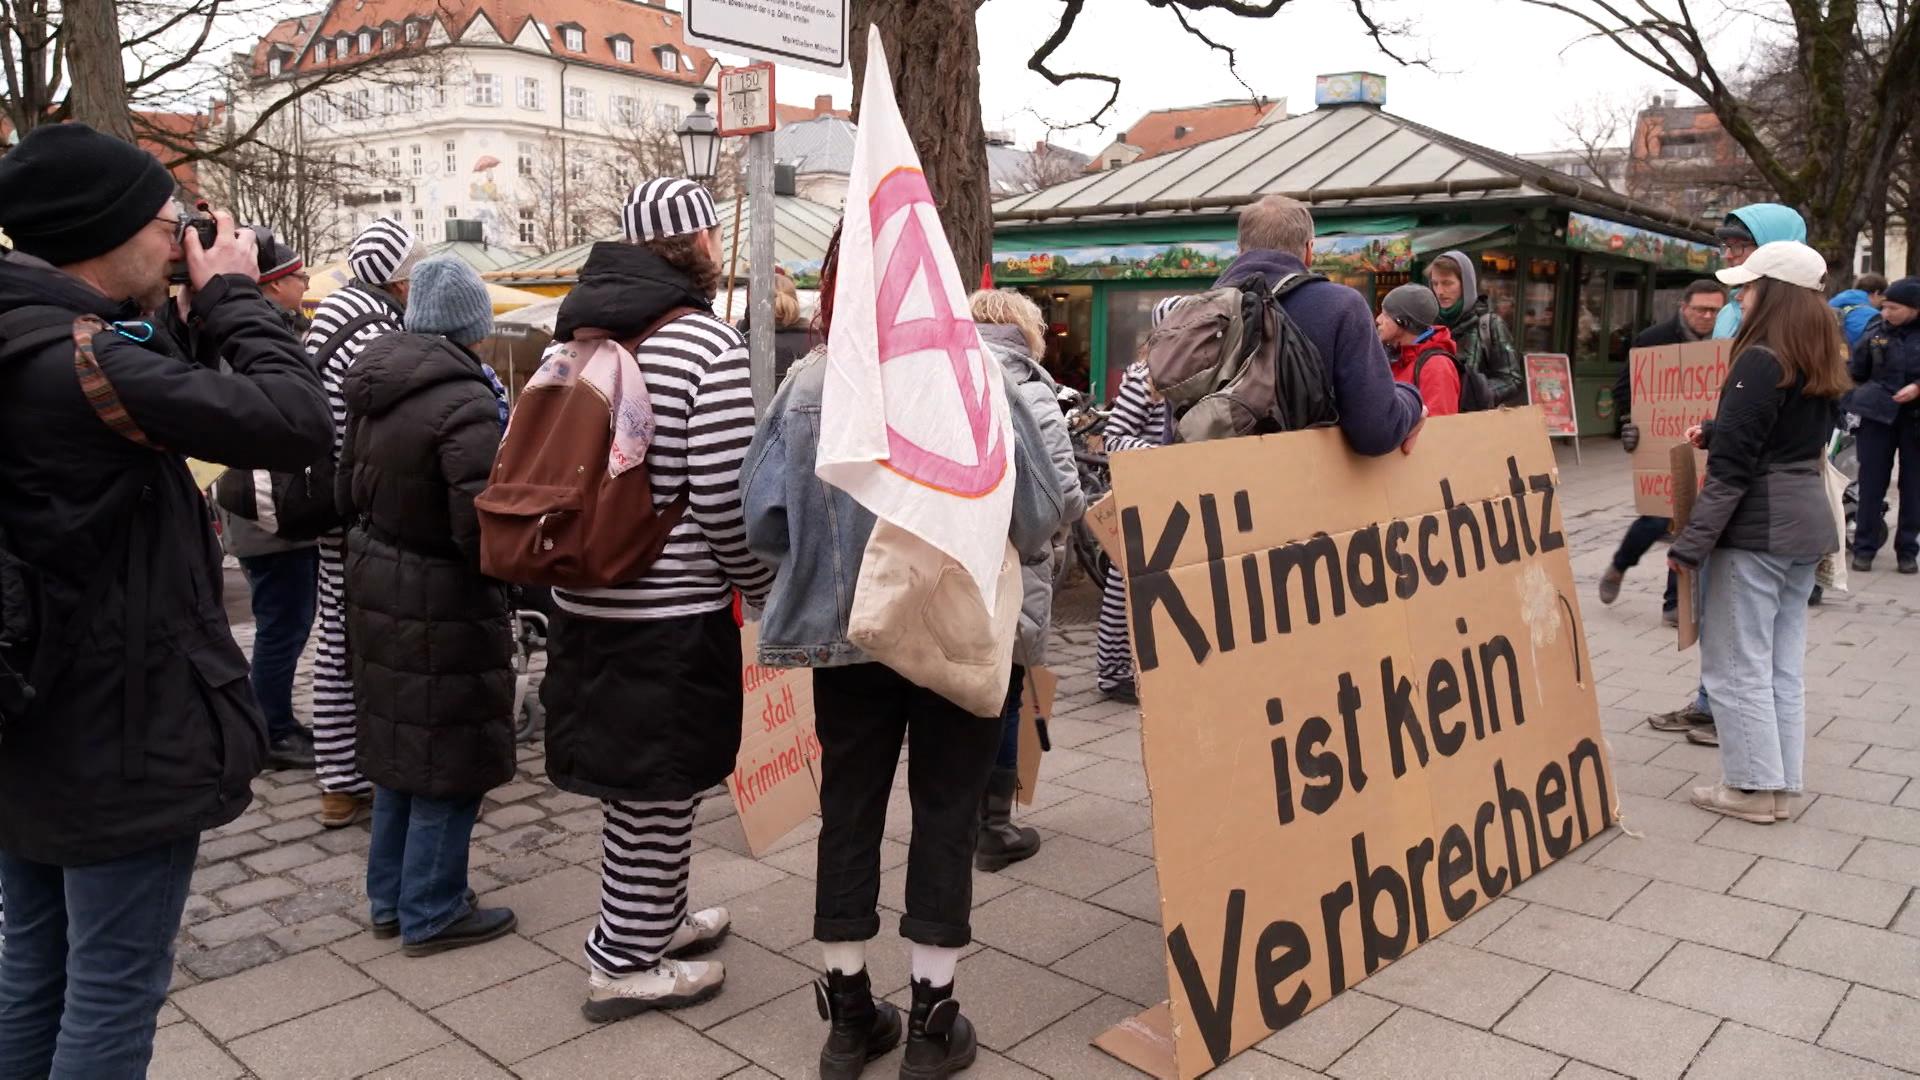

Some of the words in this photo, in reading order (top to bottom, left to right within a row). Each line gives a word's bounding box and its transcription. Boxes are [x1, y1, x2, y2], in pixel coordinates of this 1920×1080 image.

[1632, 345, 1728, 405] Klimasch
[1121, 456, 1566, 673] Klimaschutz
[762, 683, 796, 733] statt
[1266, 672, 1368, 826] ist
[1381, 617, 1525, 780] kein
[1166, 736, 1612, 1067] Verbrechen
